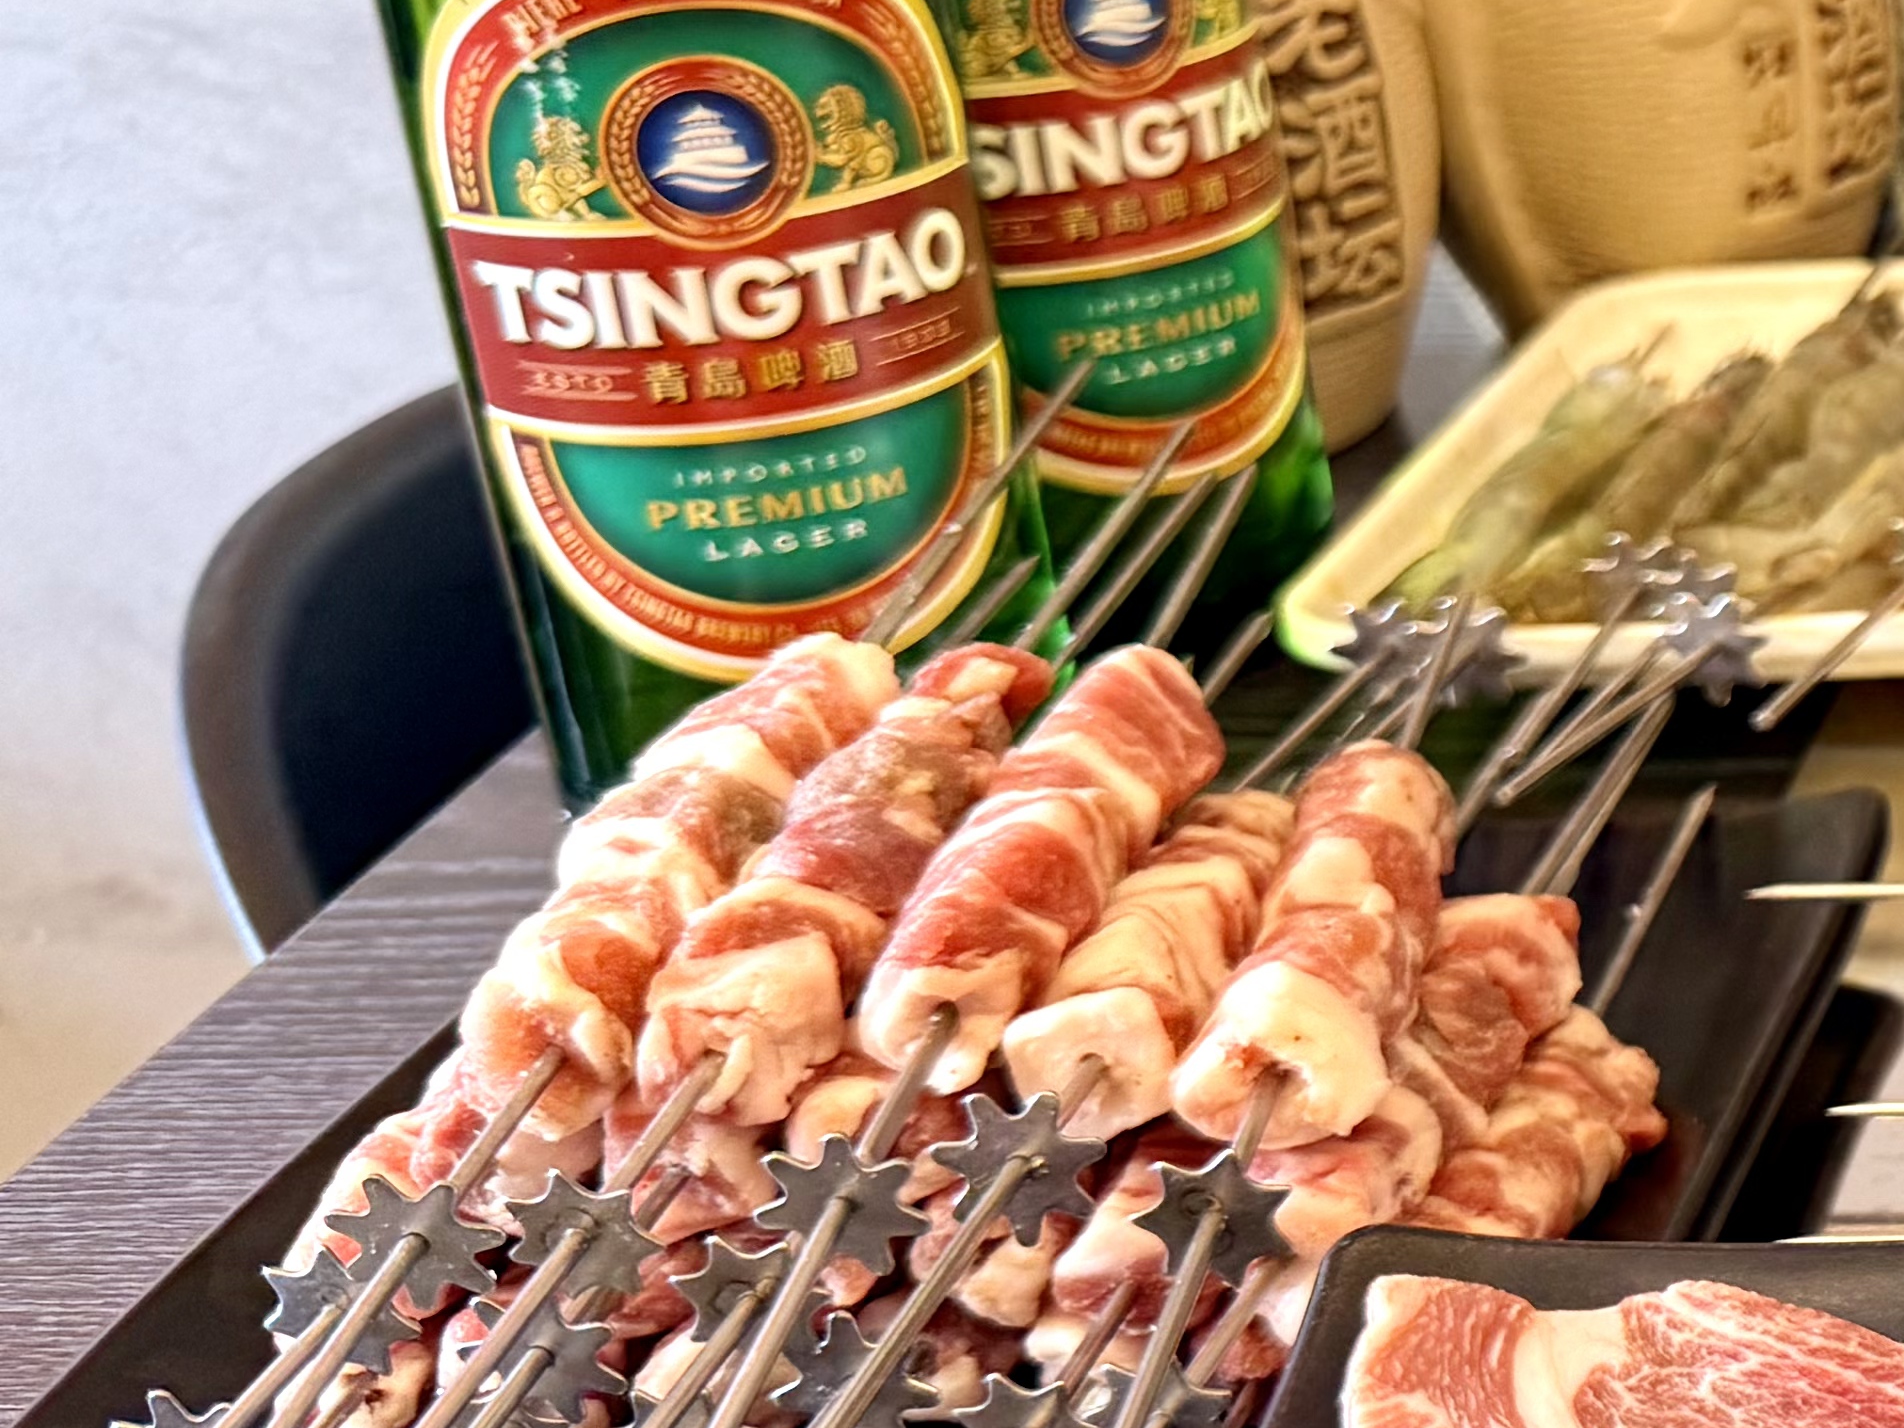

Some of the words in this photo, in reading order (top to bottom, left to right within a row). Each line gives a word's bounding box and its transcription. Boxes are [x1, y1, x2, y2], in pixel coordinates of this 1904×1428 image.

[968, 58, 1274, 202] SINGTAO
[472, 206, 967, 350] TSINGTAO
[1055, 287, 1261, 361] PREMIUM
[642, 338, 860, 408] 青島啤酒
[1102, 334, 1238, 386] LAGER
[644, 466, 909, 532] PREMIUM
[671, 445, 869, 488] IMPORTED
[700, 517, 871, 563] LAGER
